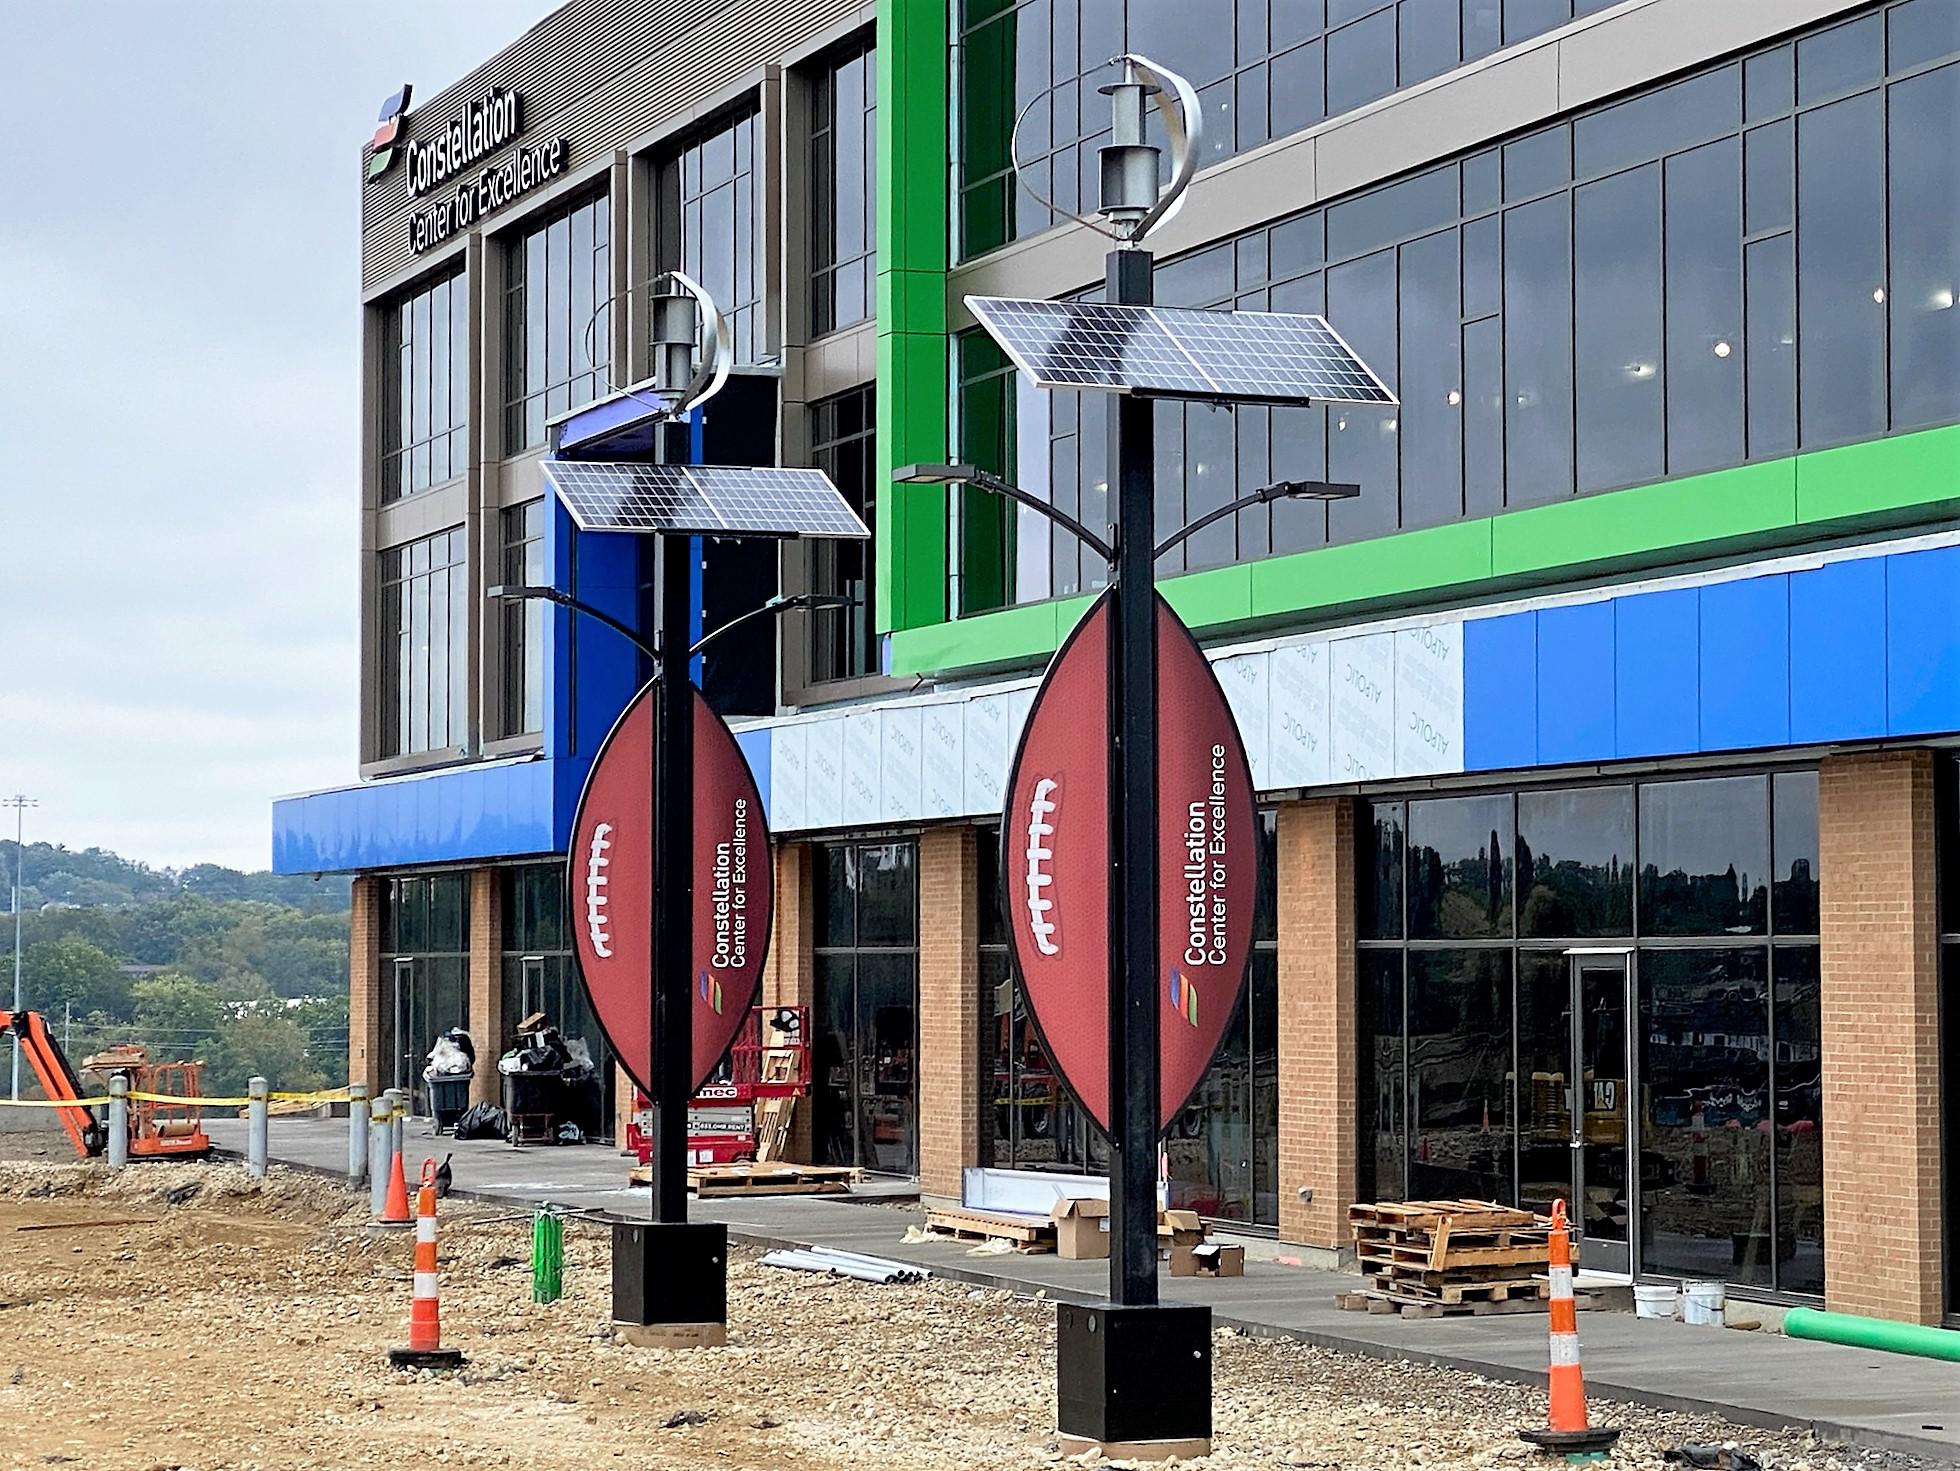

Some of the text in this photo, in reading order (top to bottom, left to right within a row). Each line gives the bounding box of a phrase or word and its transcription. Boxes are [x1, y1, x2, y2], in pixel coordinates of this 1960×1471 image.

[406, 87, 516, 196] Constellation
[408, 138, 560, 255] Center for Excellence
[712, 842, 730, 968] Constellation
[730, 798, 746, 968] Center for Excellence
[1184, 801, 1206, 966] Constellation
[1207, 744, 1227, 966] Center for Excellence
